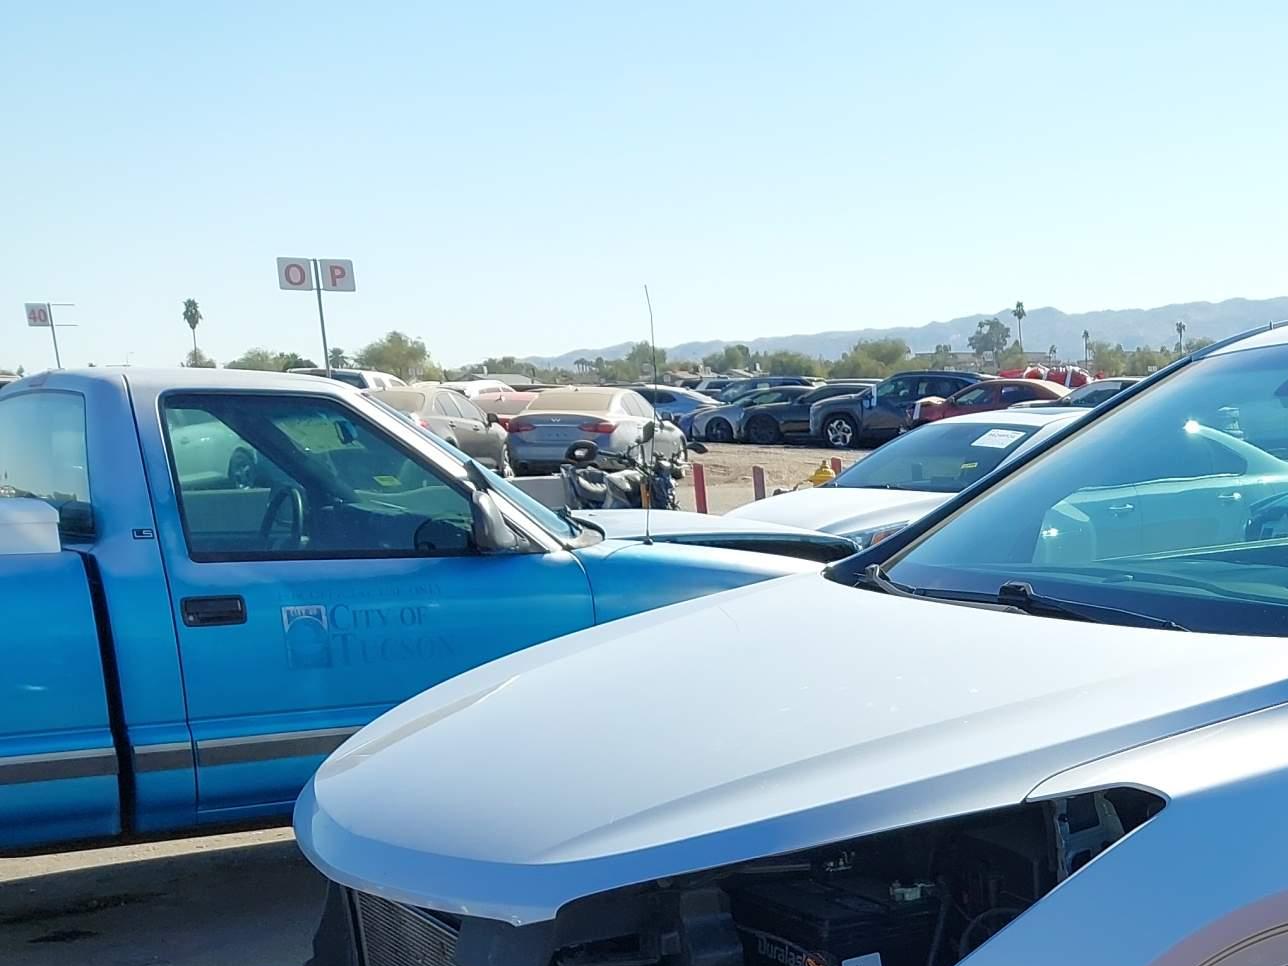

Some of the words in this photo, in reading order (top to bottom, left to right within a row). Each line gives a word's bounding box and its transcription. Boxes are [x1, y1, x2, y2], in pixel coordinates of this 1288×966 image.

[284, 263, 305, 286] O
[329, 265, 346, 287] P
[28, 308, 48, 323] 40
[134, 526, 153, 538] LS
